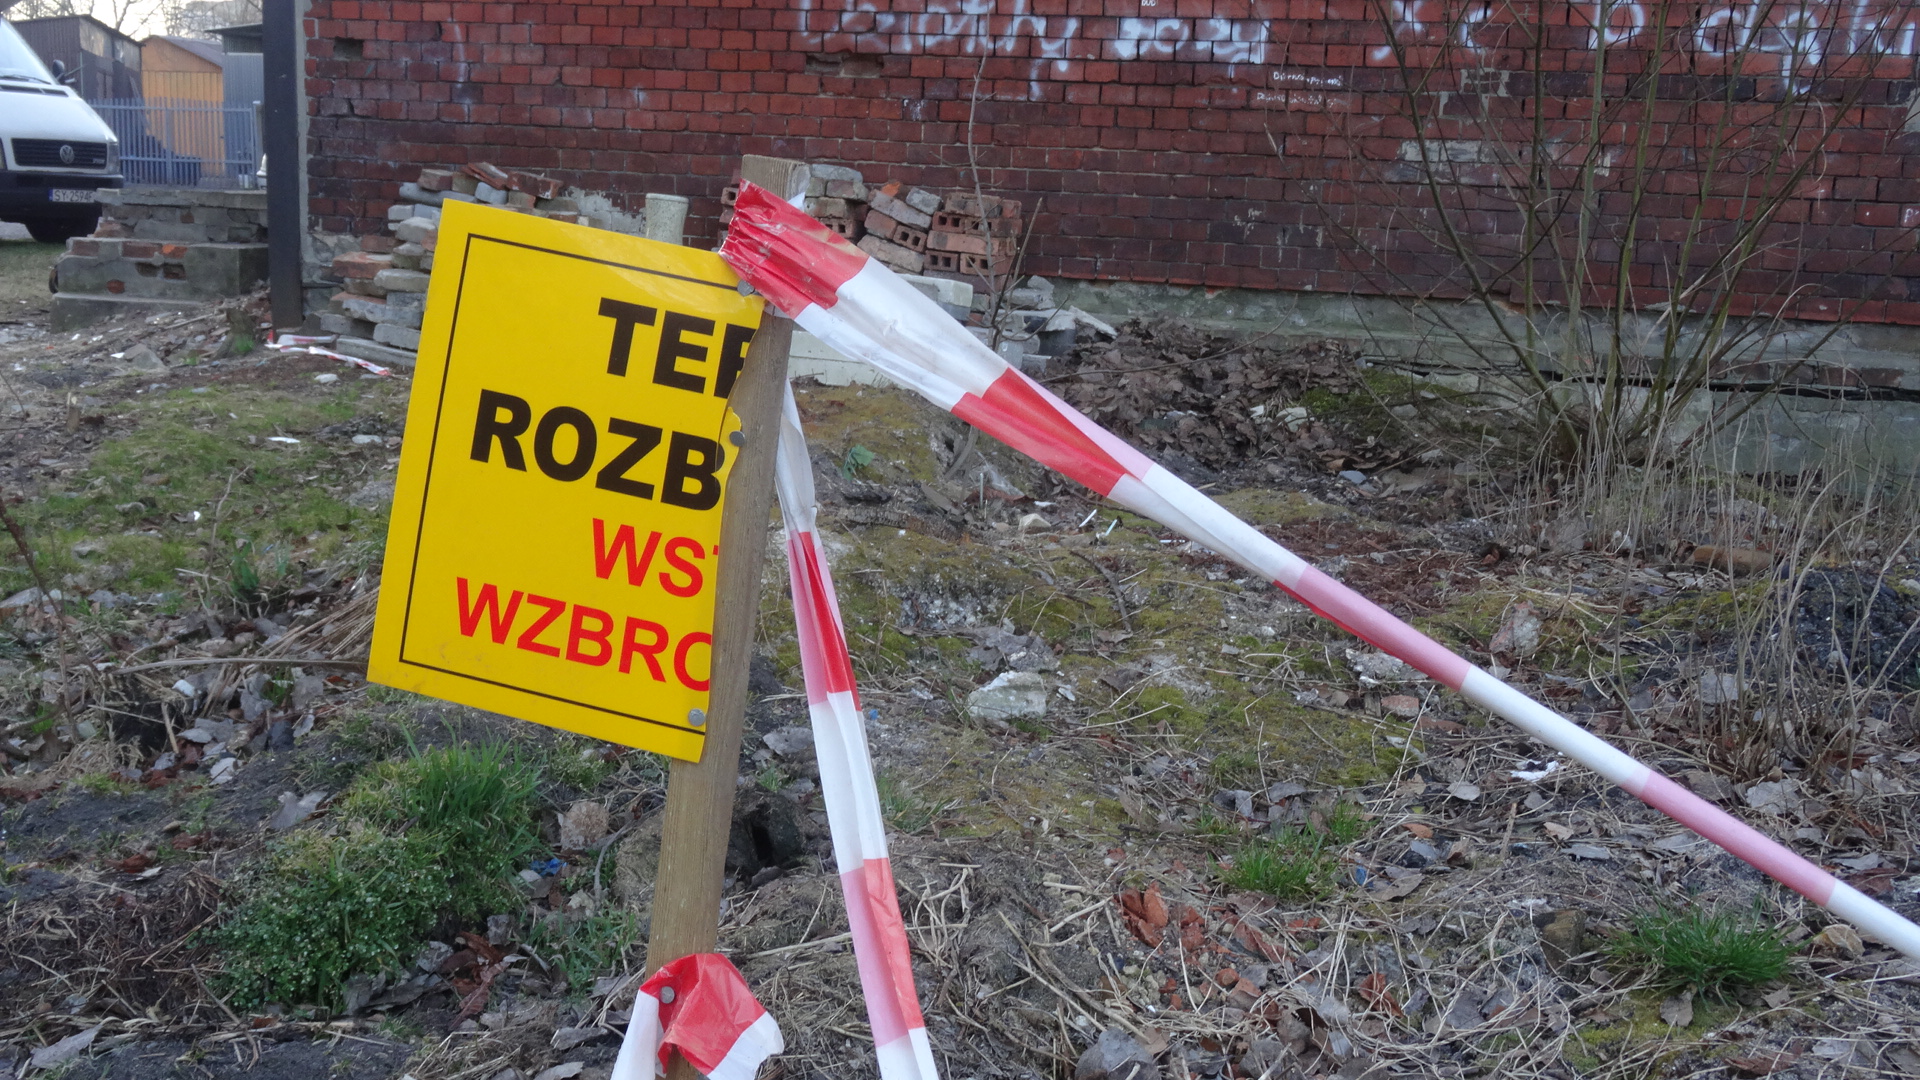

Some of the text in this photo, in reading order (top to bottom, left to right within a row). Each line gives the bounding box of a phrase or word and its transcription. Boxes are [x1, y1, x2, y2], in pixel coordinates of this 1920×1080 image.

[54, 189, 67, 201] SY
[470, 388, 725, 511] ROZB
[592, 517, 718, 597] WS
